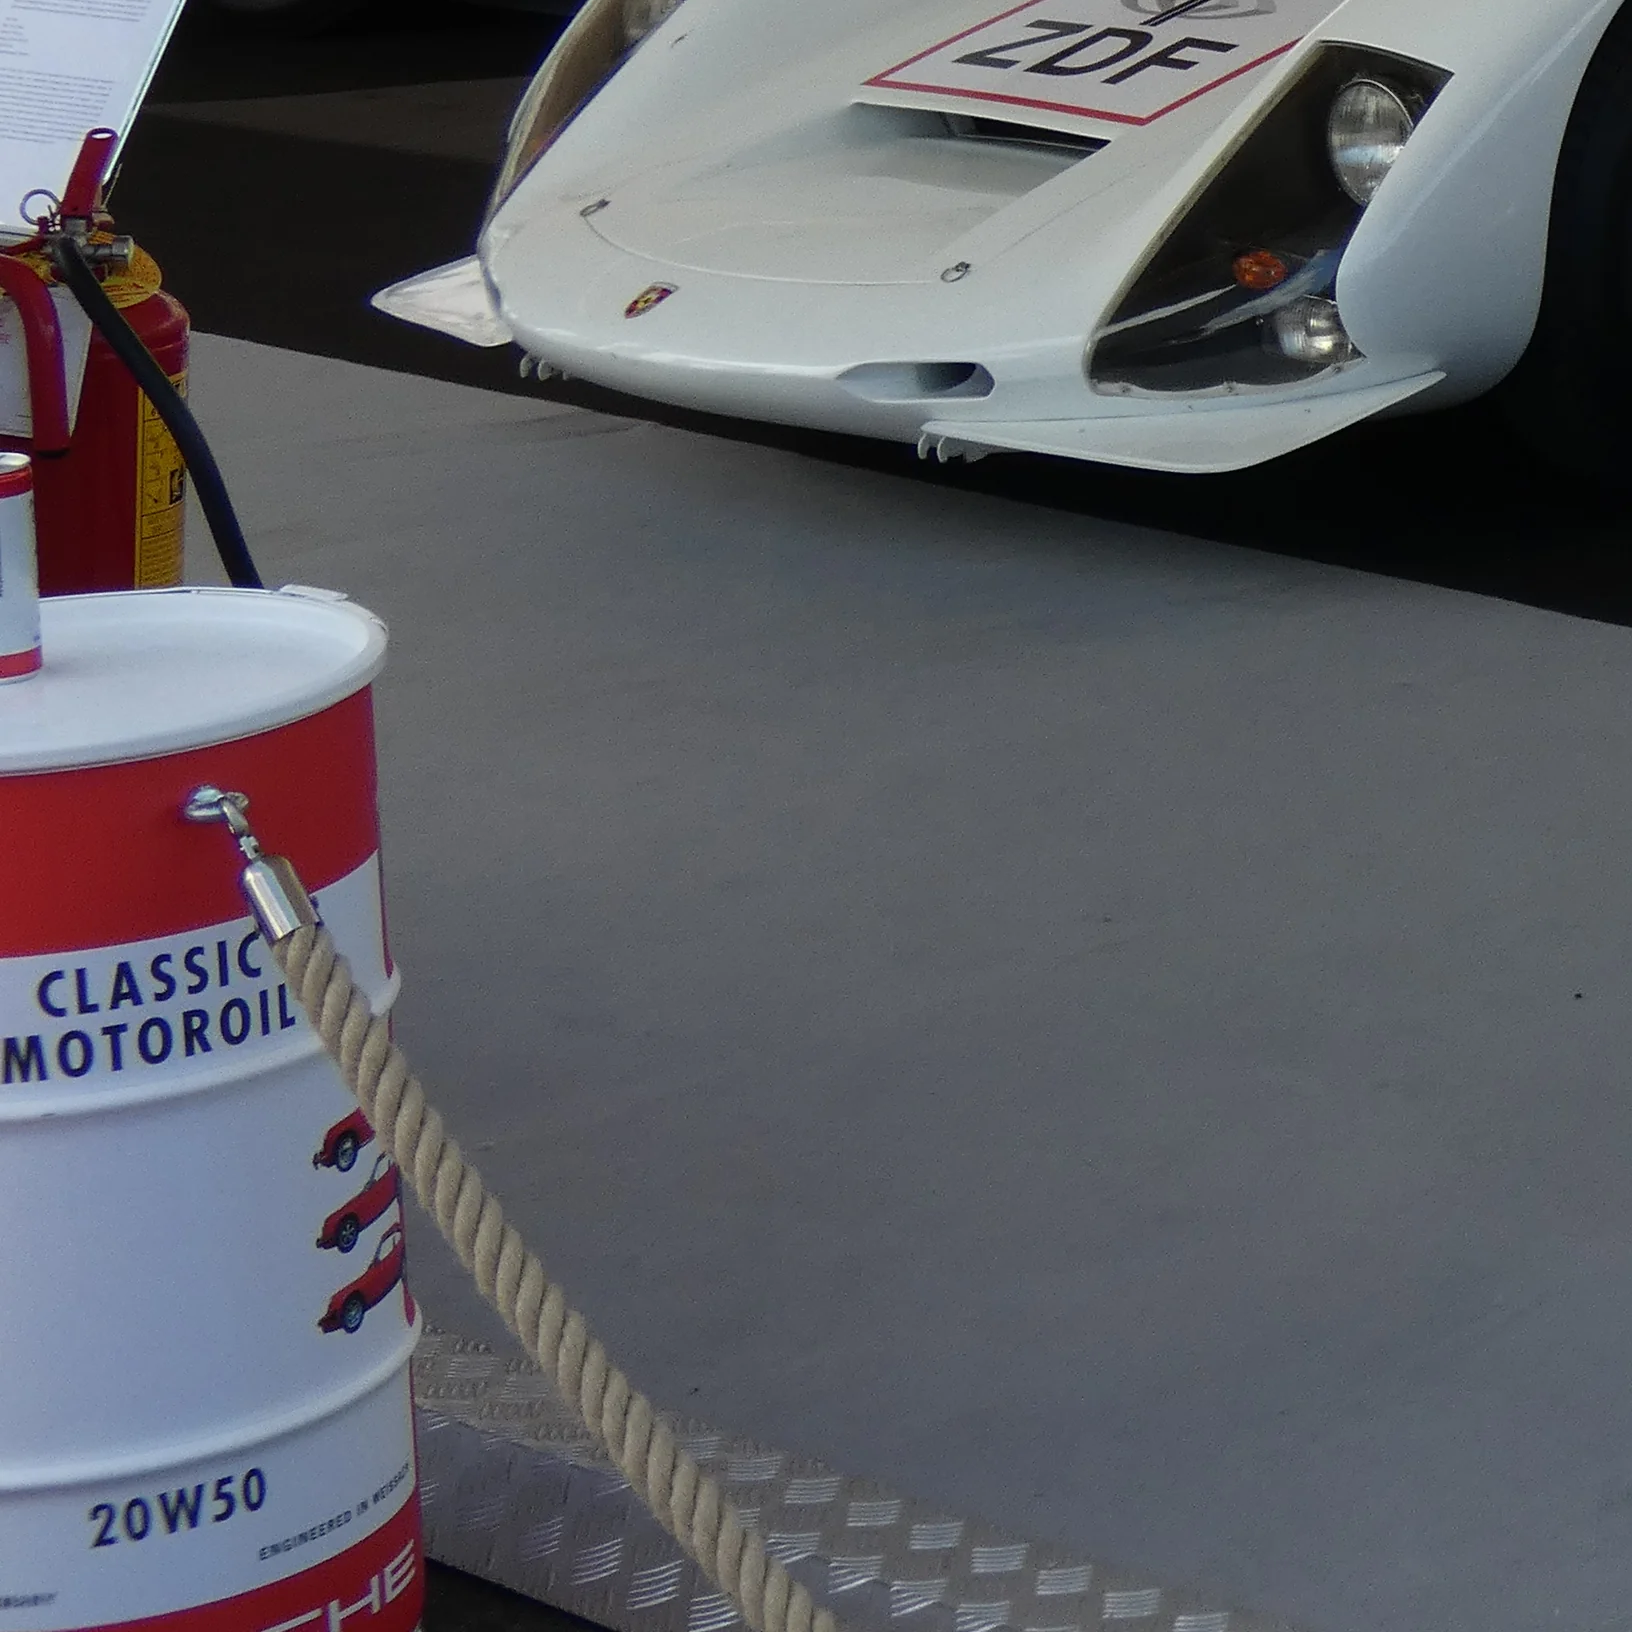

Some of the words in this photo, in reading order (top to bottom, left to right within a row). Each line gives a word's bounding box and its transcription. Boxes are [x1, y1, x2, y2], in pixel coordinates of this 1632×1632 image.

[952, 18, 1240, 86] ZDF
[38, 930, 262, 1019] CLASSIC
[1, 982, 297, 1086] MOTOROIL
[88, 1467, 268, 1550] 20W50
[259, 1509, 353, 1562] ENGINEERED
[356, 1499, 369, 1517] IN
[262, 1538, 416, 1632] HE
